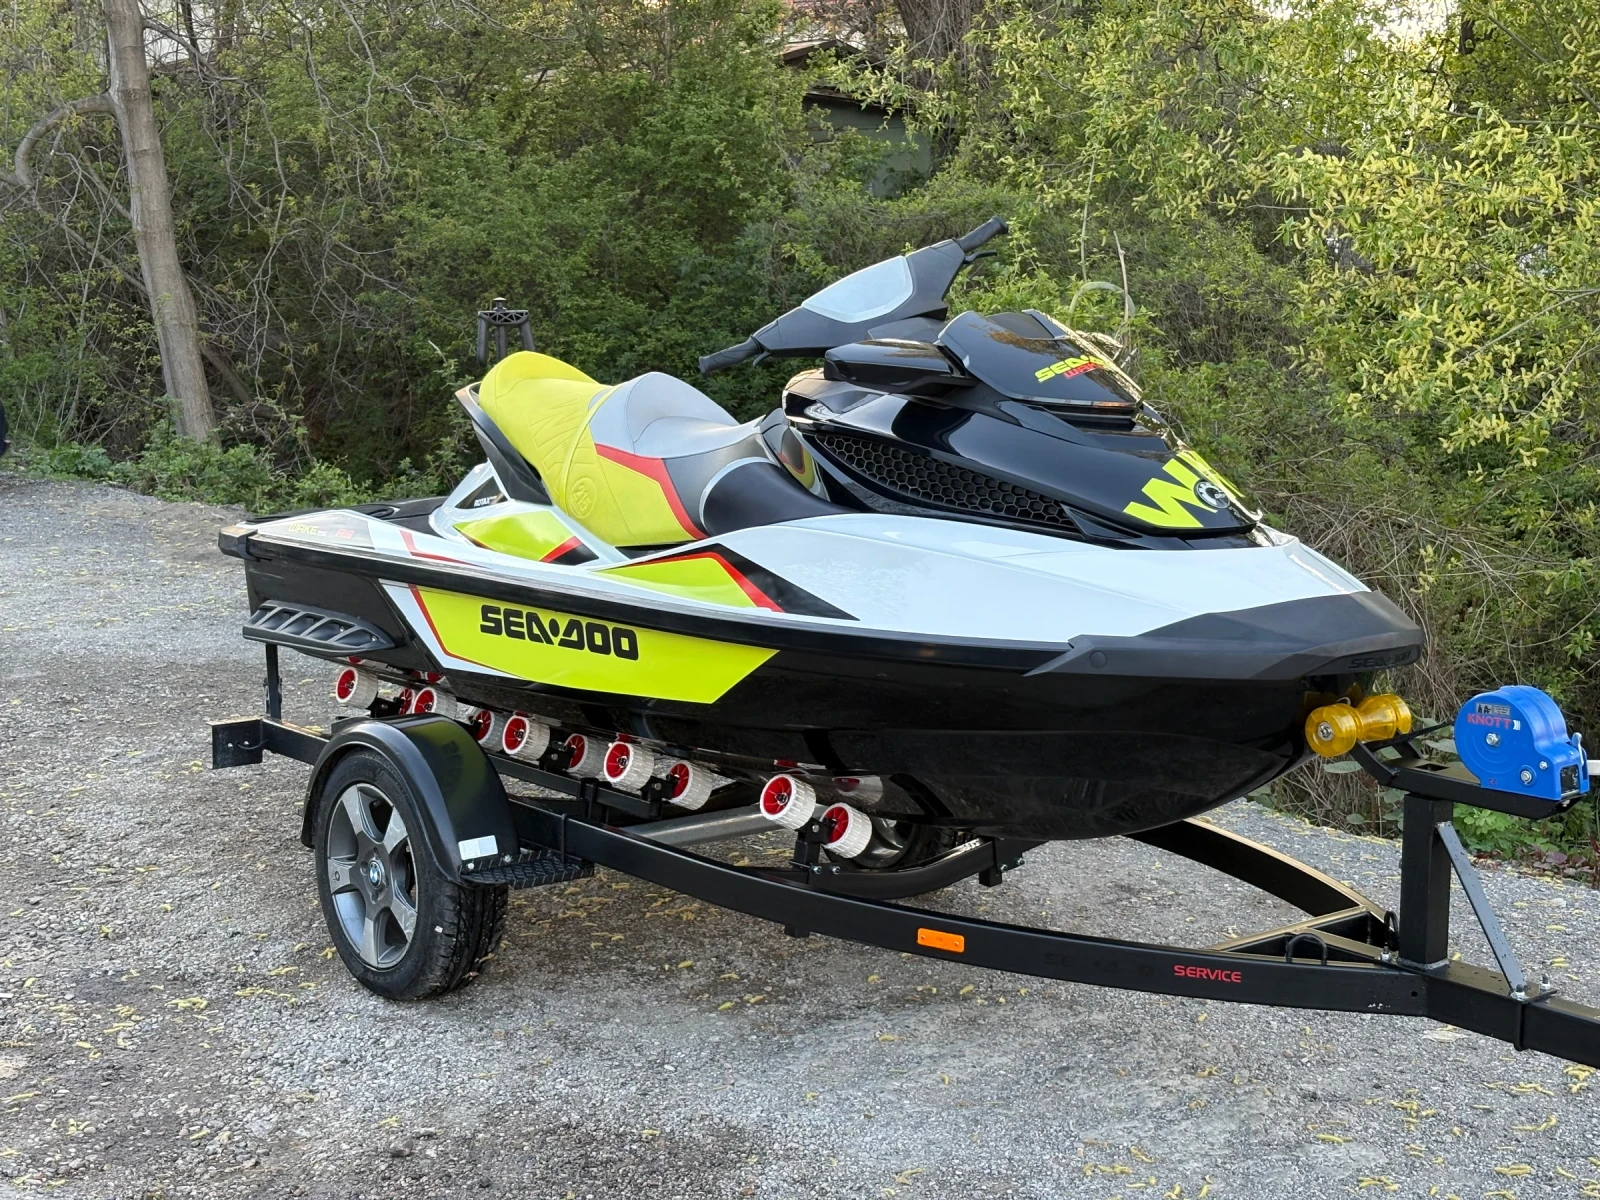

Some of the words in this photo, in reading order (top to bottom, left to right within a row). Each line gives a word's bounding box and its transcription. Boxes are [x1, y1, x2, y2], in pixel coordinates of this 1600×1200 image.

[287, 523, 319, 535] WAKE
[1467, 712, 1511, 730] KNOTT
[1174, 964, 1242, 983] SERVICE
